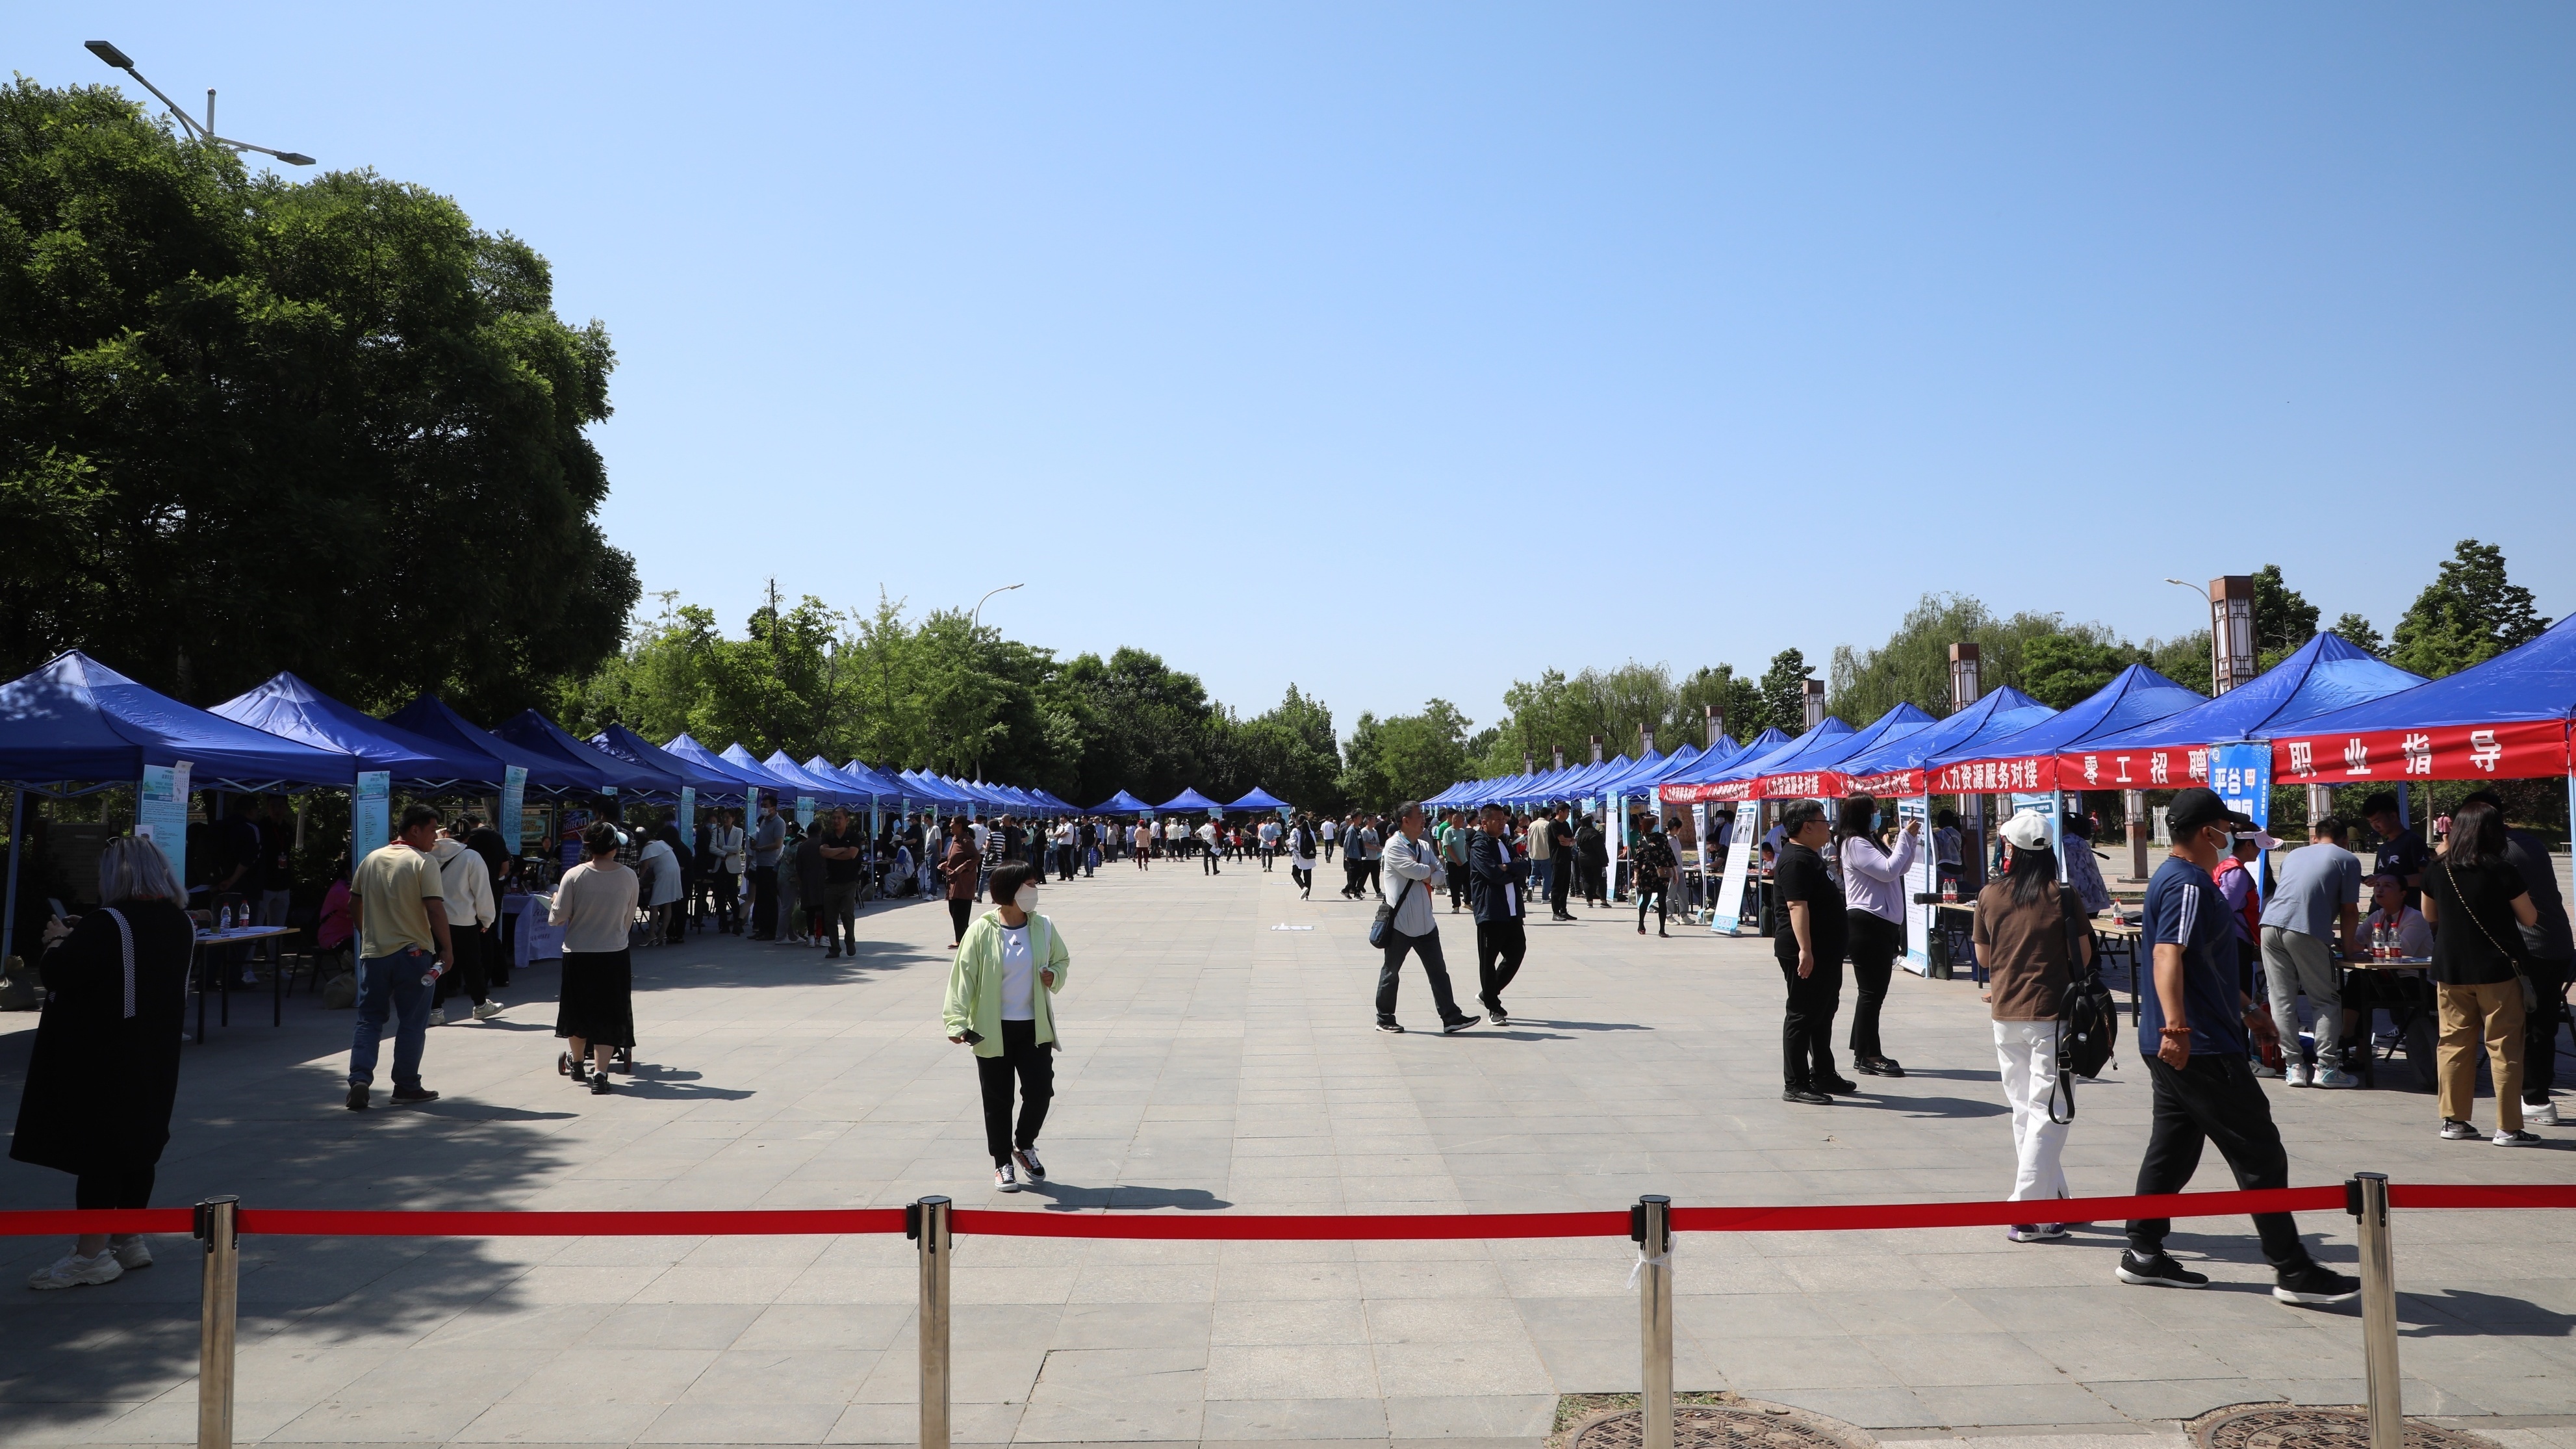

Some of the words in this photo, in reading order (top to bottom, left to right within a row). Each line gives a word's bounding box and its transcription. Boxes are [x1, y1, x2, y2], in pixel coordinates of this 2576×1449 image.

[2084, 749, 2209, 786] 零工招聘
[2288, 730, 2502, 778] 职业指导
[1766, 773, 1819, 796] 人力资源服务对接
[1940, 759, 2038, 790] 人力资源服务对接
[1664, 786, 1698, 802] 人力资源服务对接
[563, 817, 587, 832] Hilton
